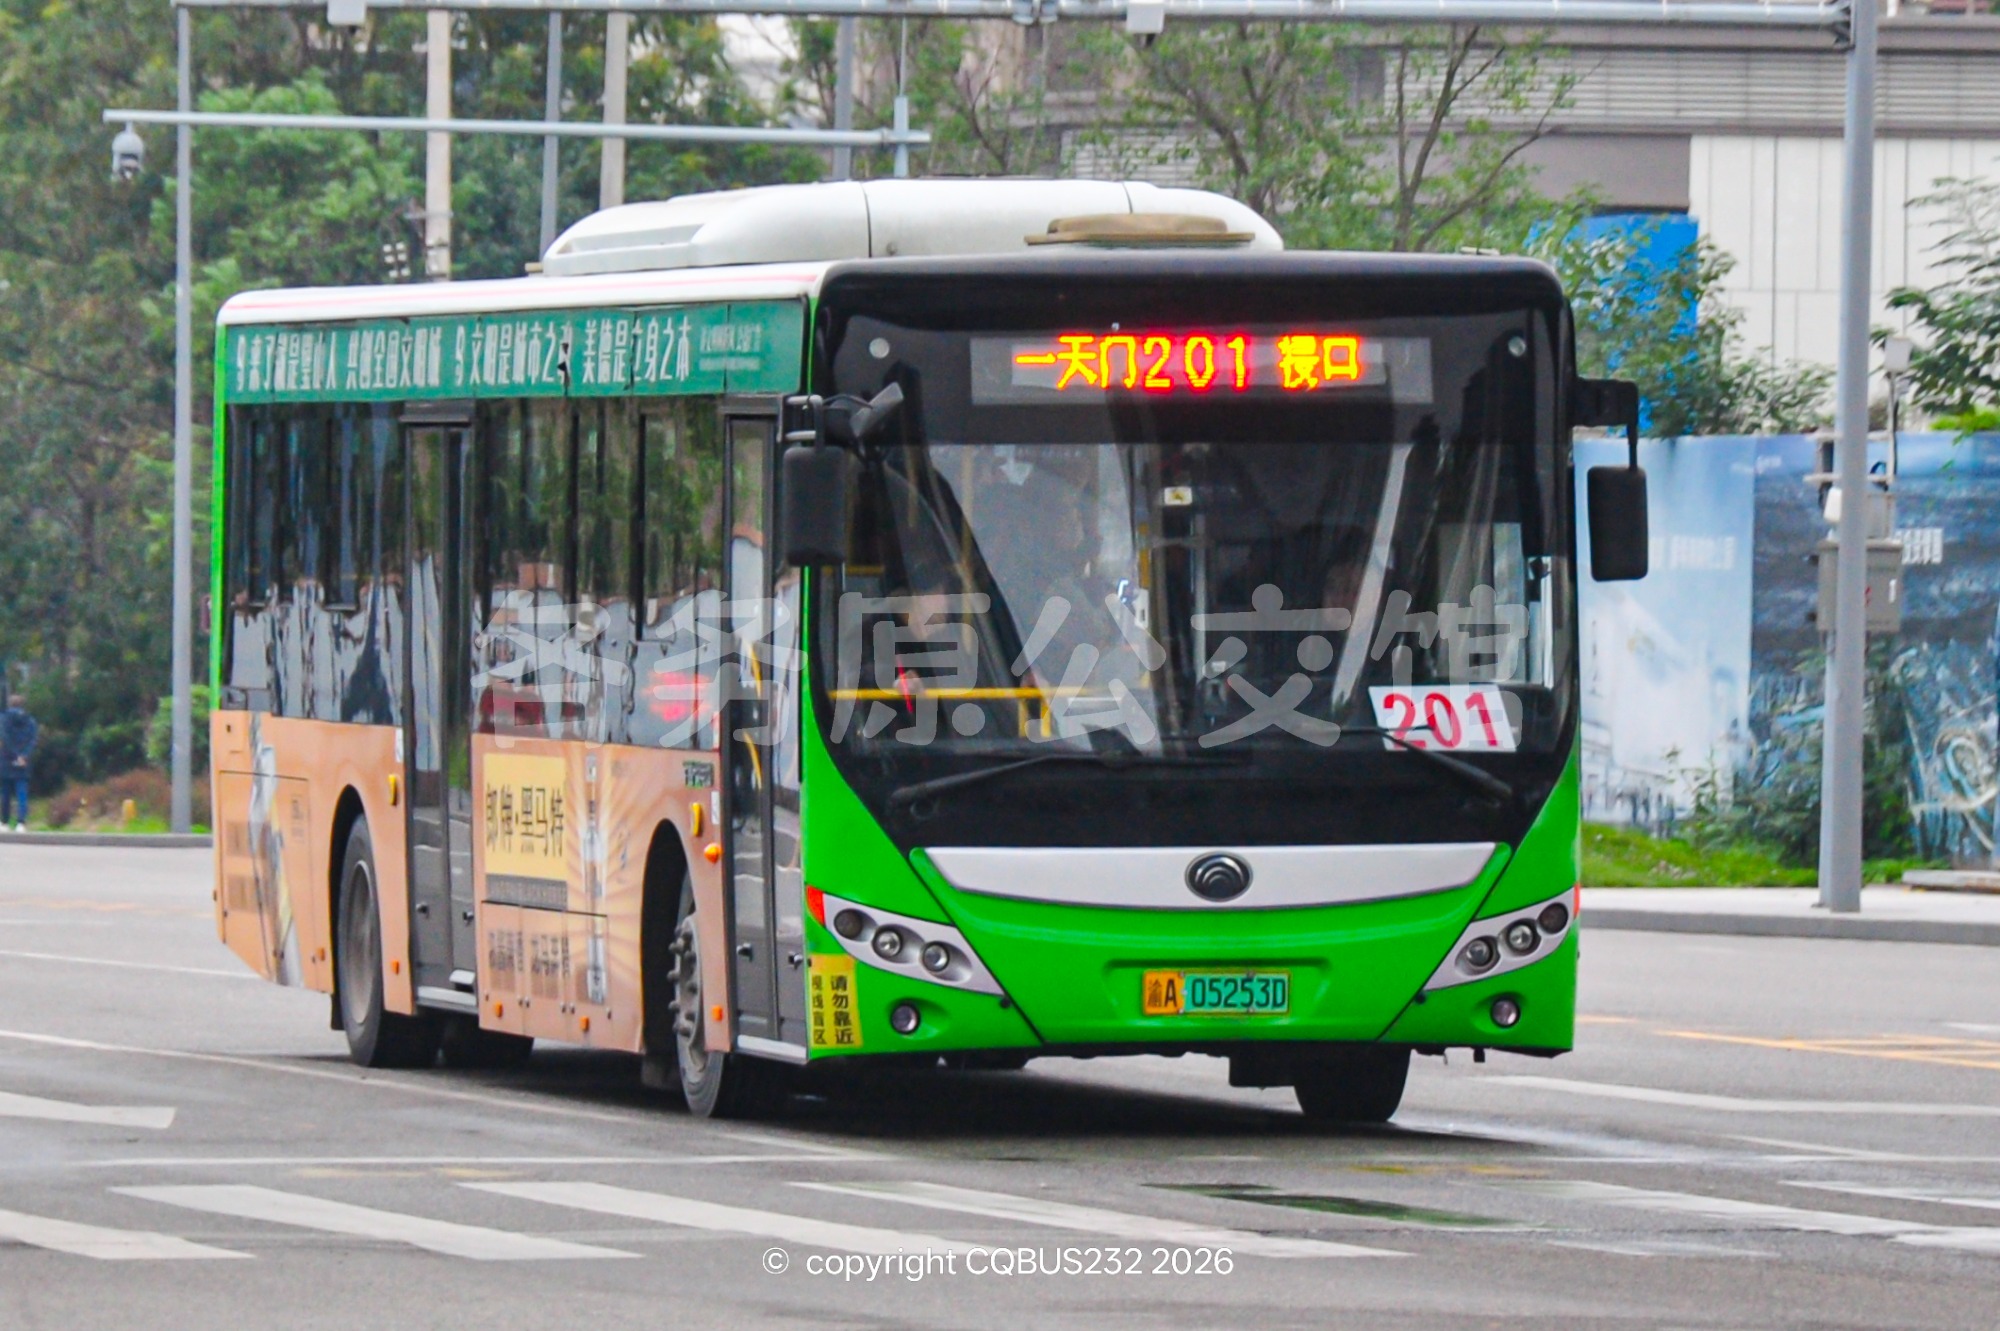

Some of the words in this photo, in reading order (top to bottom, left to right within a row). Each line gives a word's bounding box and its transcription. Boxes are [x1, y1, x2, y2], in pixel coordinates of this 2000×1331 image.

[582, 316, 693, 385] 美德是立身之本
[1015, 335, 1137, 390] 一天门
[1142, 335, 1247, 390] 201
[1383, 691, 1499, 749] 201
